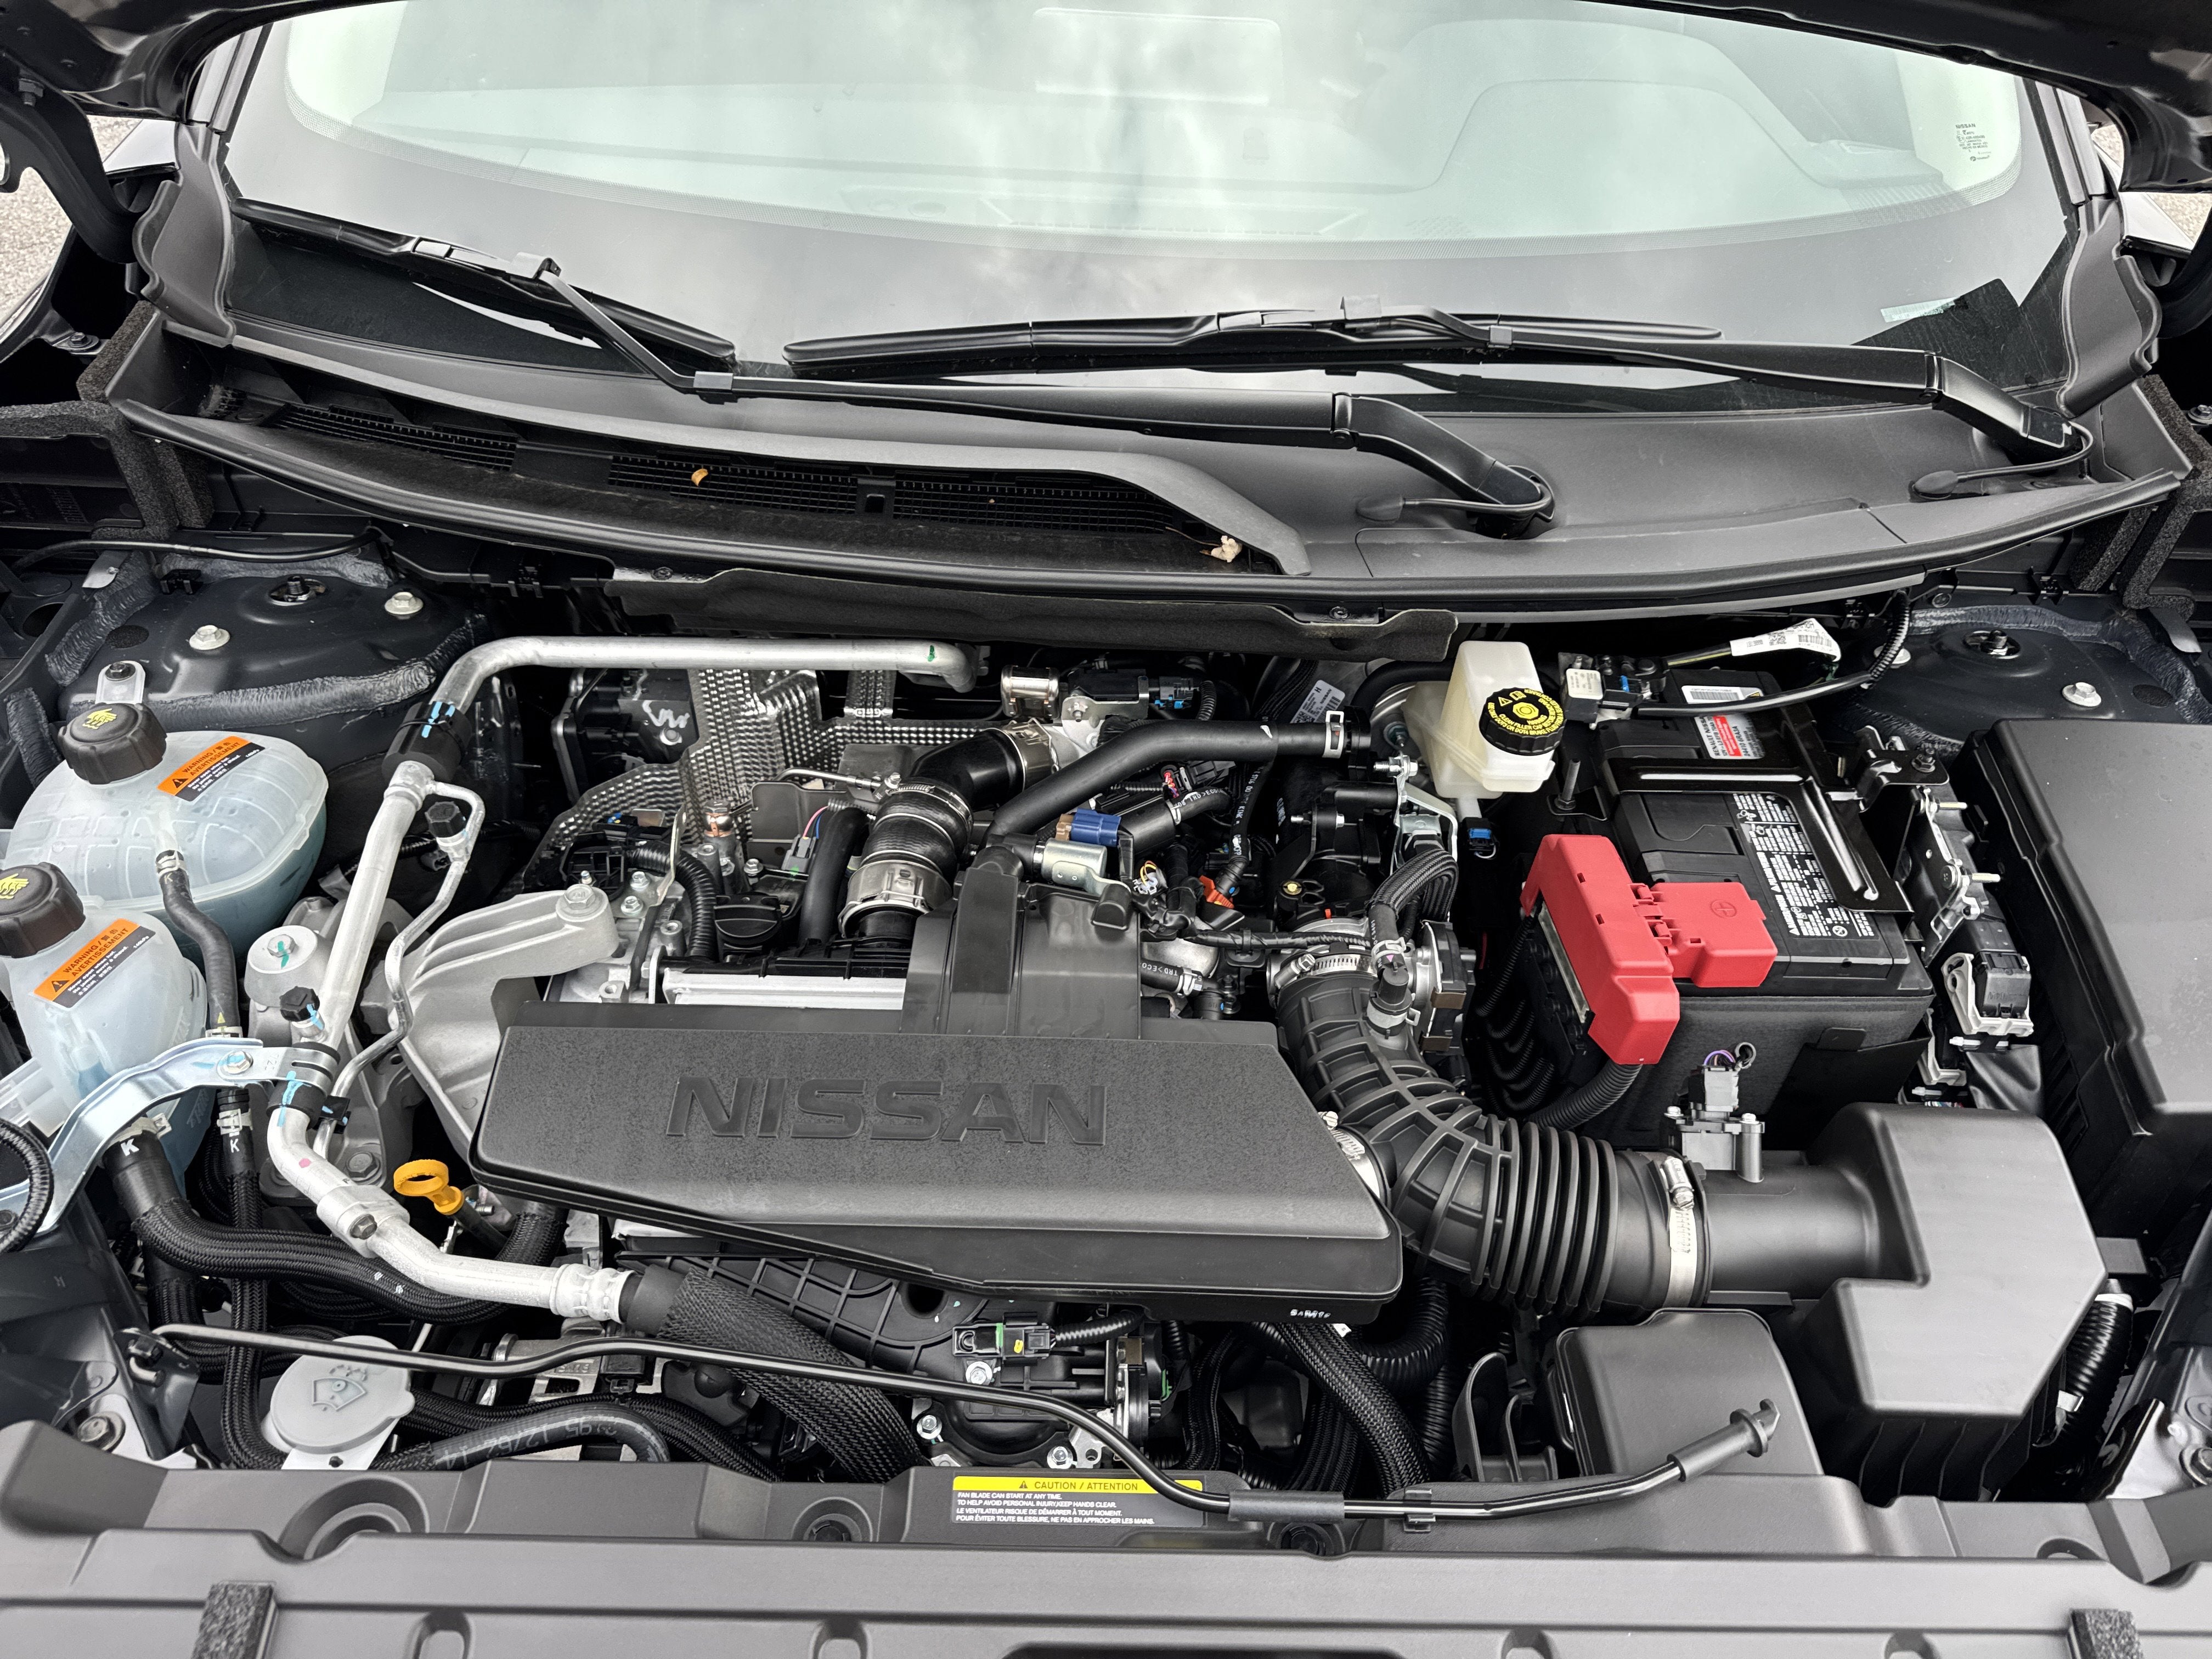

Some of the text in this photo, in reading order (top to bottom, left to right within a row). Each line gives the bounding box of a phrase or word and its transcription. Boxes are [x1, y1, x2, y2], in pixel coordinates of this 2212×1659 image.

[1699, 716, 1711, 733] NISSA
[1707, 735, 1720, 756] RENAULT
[182, 752, 213, 772] WARNING
[190, 742, 240, 776] AVERTISSEMENT
[63, 944, 99, 973] WARNING
[71, 928, 129, 977] AVERTISSEMENT
[666, 1076, 1107, 1146] NISSAN
[120, 1138, 139, 1156] K
[230, 1138, 240, 1153] K
[1034, 1481, 1076, 1489] CAUTION
[1087, 1482, 1138, 1491] ATTENTION
